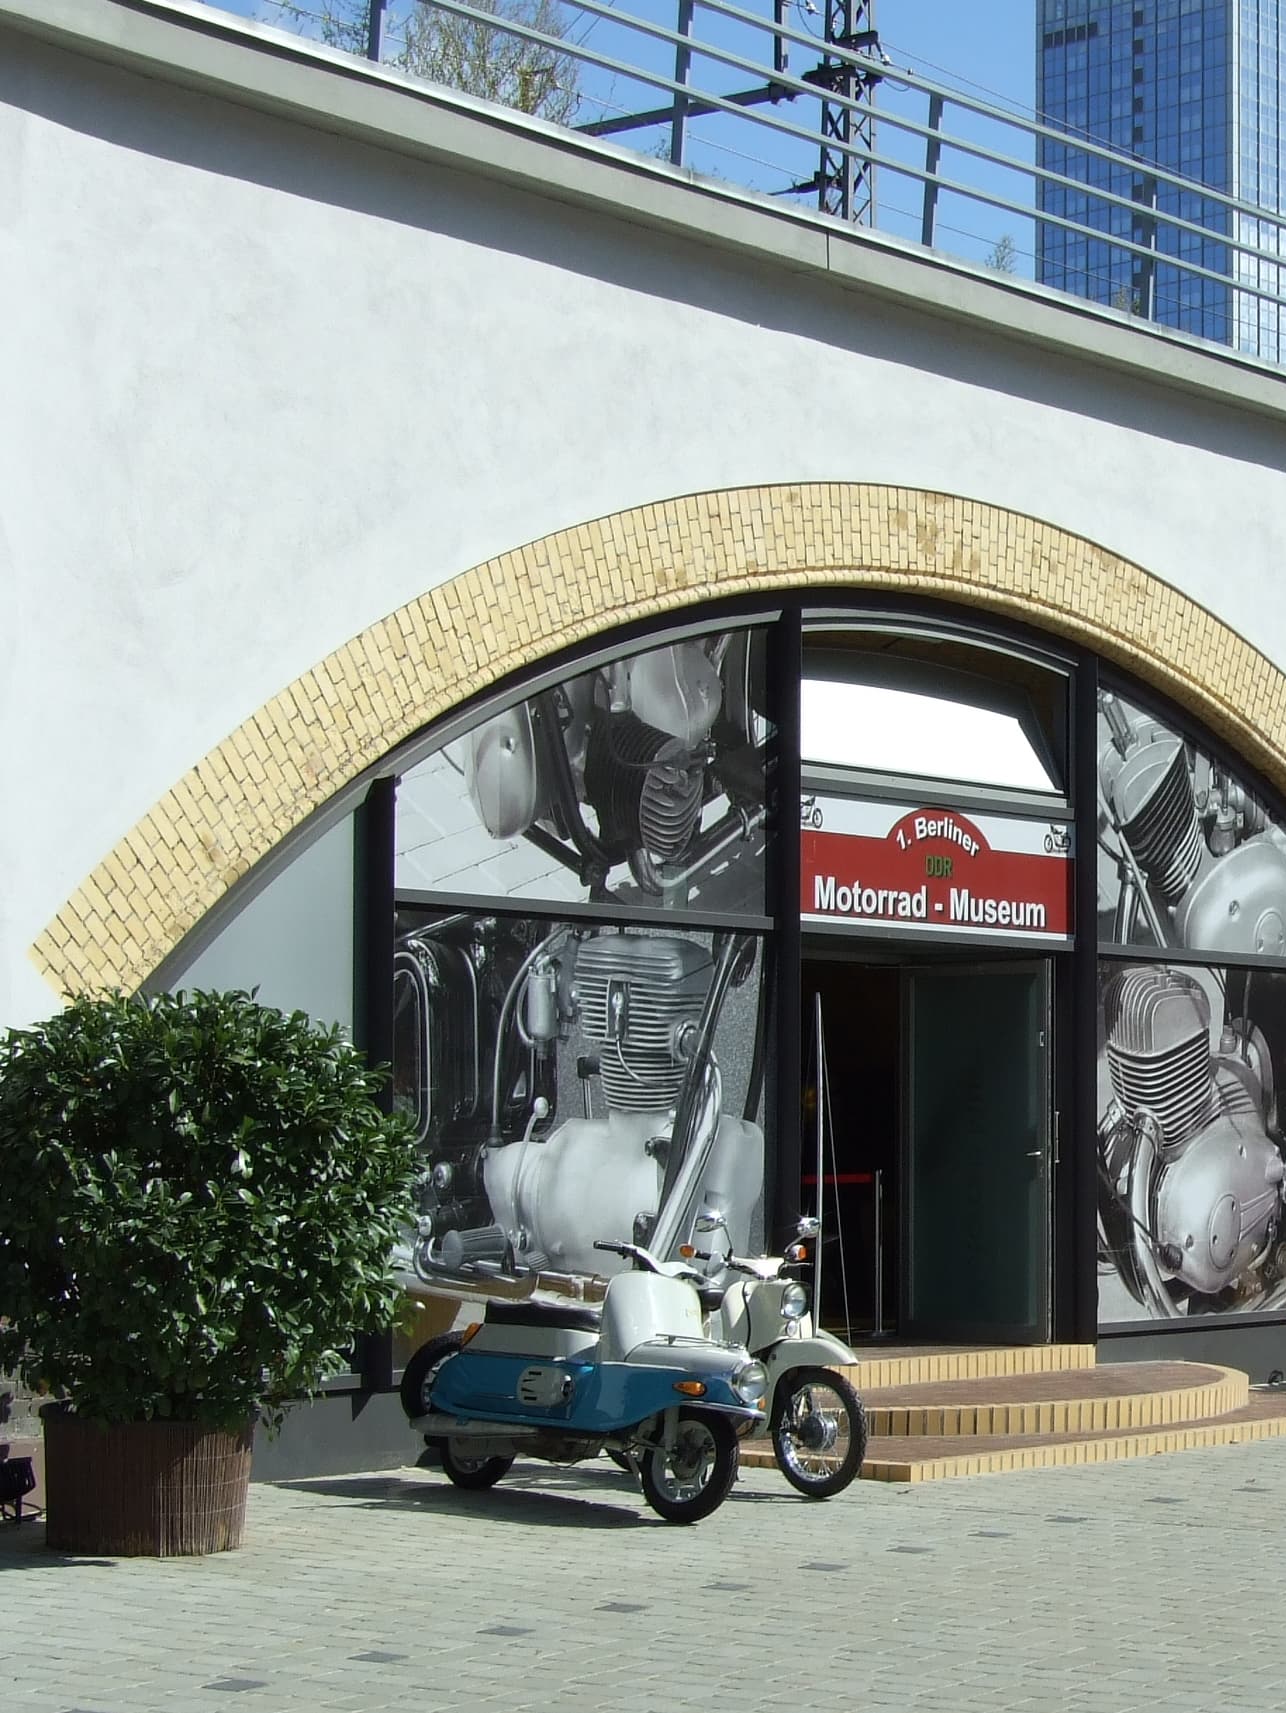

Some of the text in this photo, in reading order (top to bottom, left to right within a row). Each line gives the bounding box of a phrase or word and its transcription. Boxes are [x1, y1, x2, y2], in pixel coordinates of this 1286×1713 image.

[897, 816, 980, 856] 1. Berliner
[925, 855, 952, 877] DDR
[814, 875, 927, 918] Motorrad
[950, 887, 1046, 927] Museum
